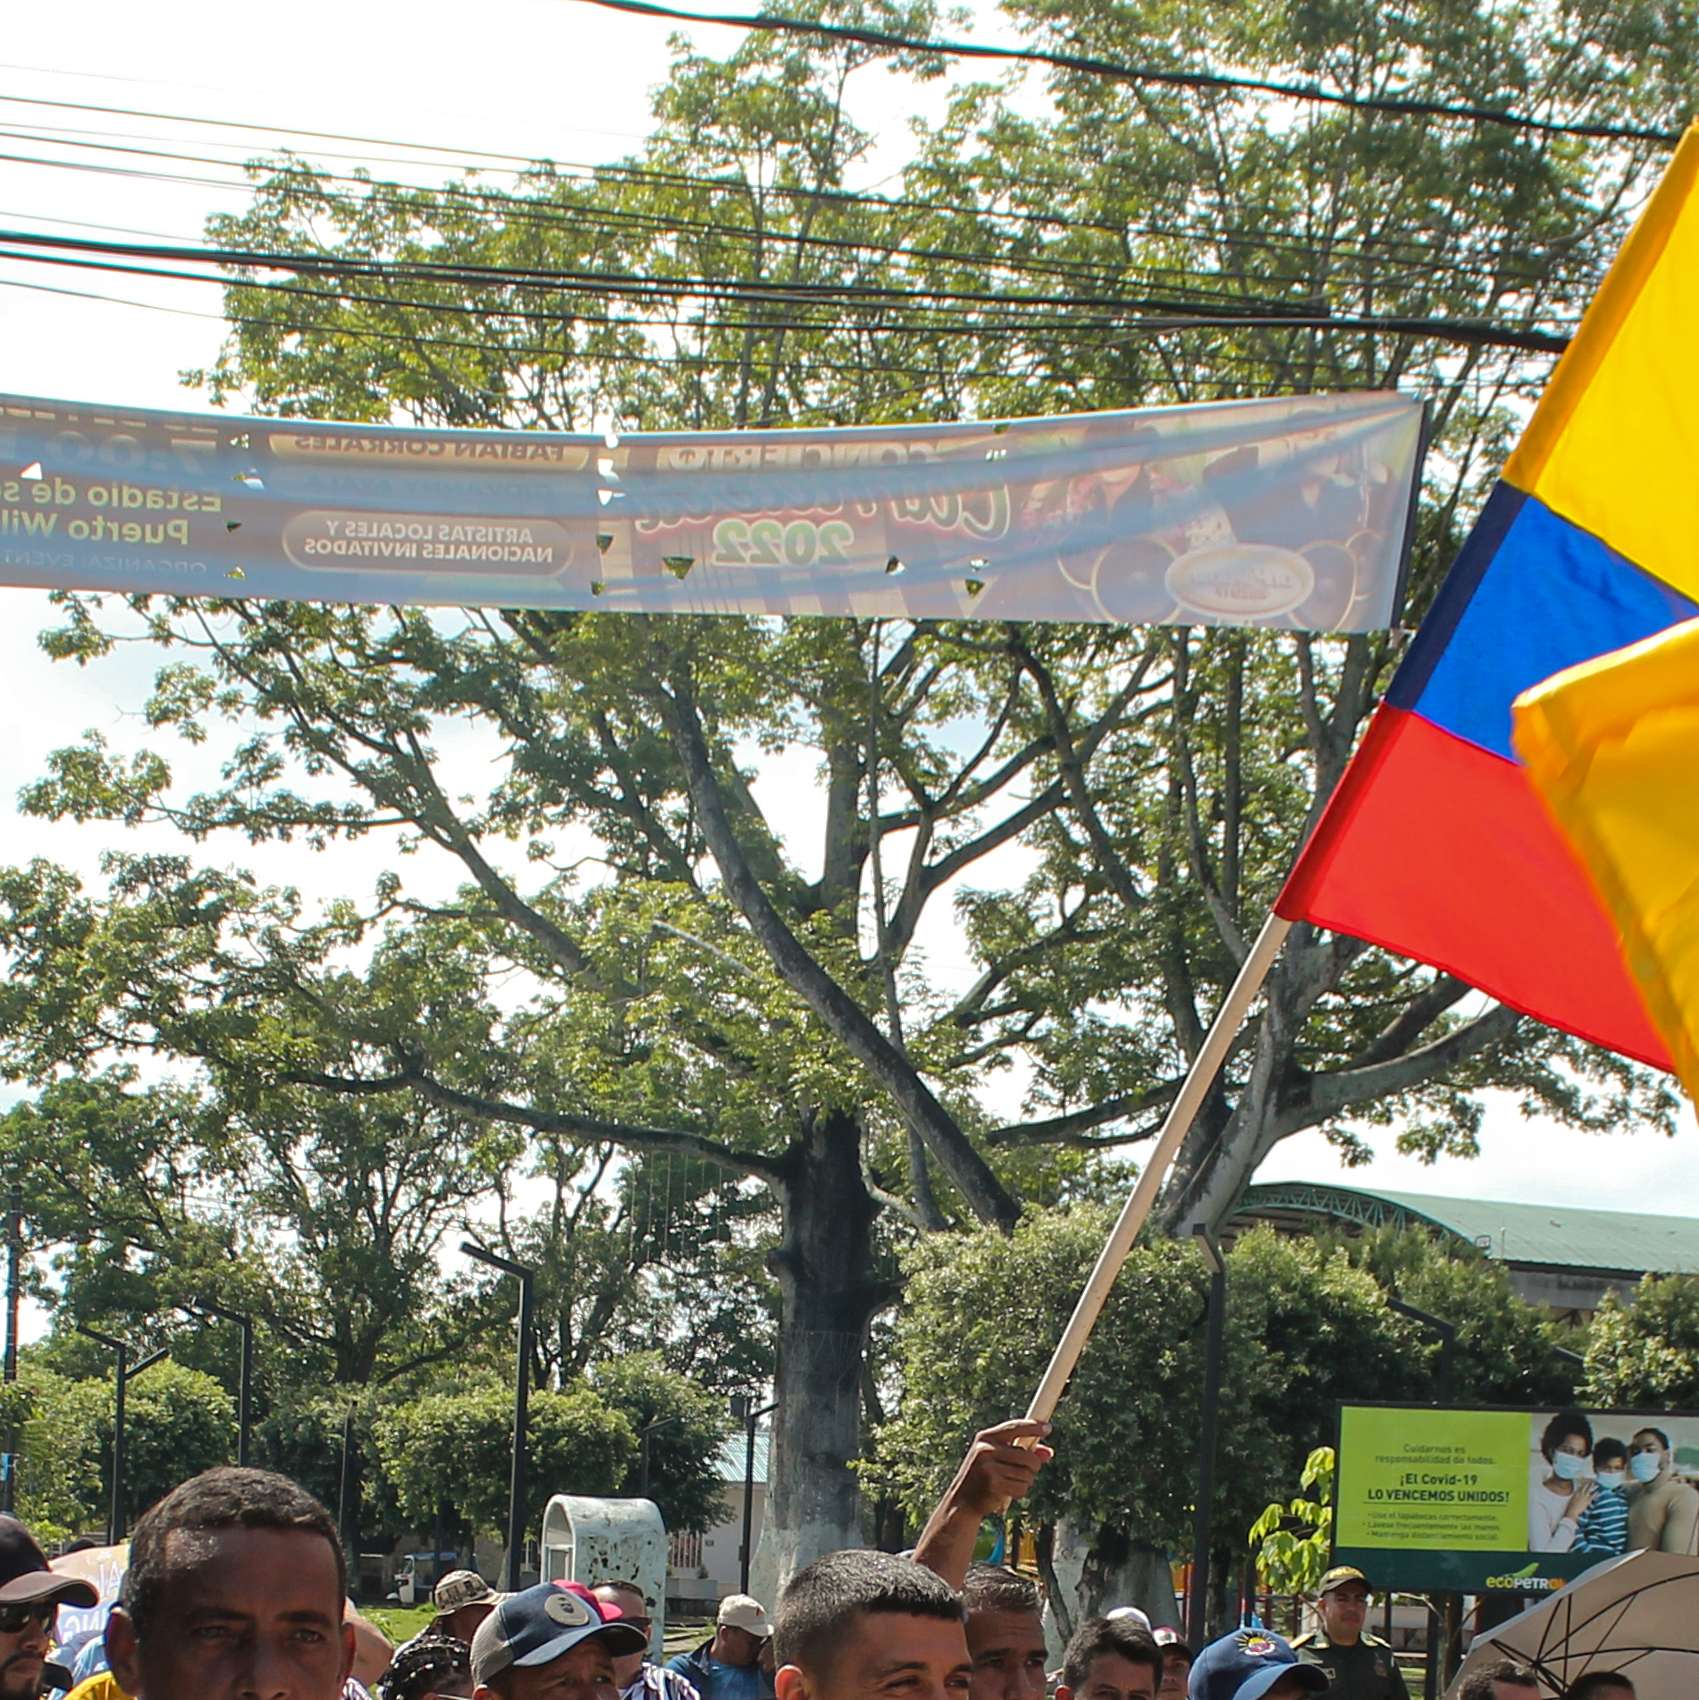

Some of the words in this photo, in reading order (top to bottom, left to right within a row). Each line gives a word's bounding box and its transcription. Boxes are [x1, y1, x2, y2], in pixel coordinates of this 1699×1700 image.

[1403, 1443, 1452, 1454] Cuidarnos
[1375, 1454, 1451, 1465] responsabilidad
[1421, 1474, 1478, 1486] Covid-19
[1368, 1489, 1383, 1500] LO
[1387, 1490, 1455, 1502] VENCEMOS
[1457, 1491, 1510, 1503] UNIDOS!
